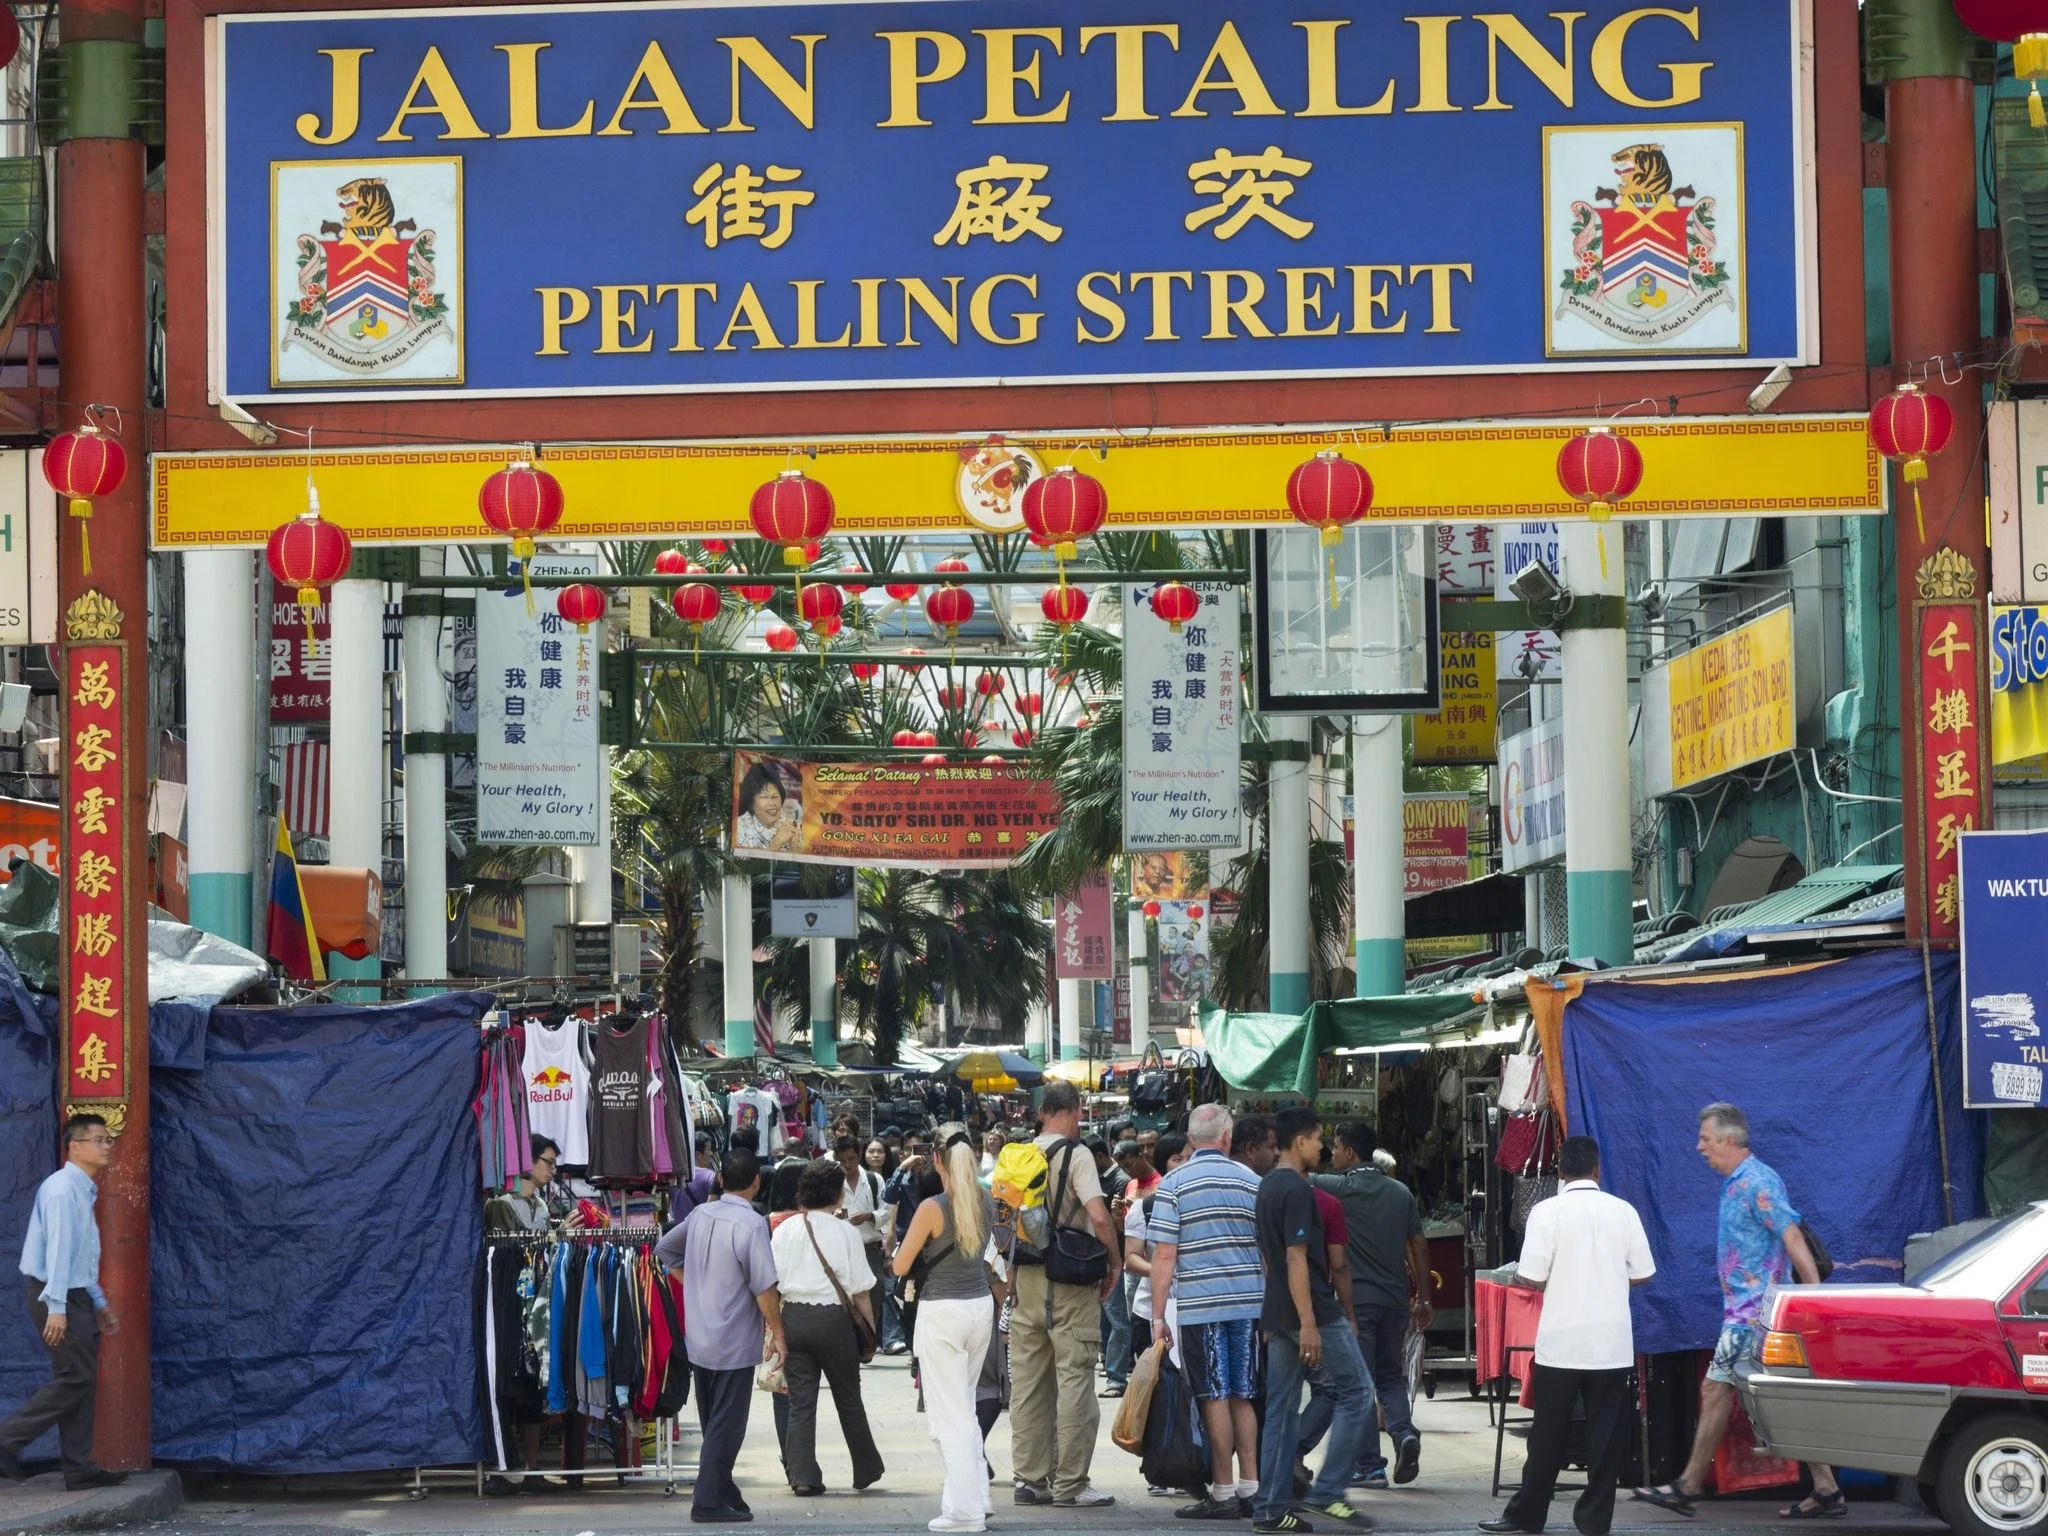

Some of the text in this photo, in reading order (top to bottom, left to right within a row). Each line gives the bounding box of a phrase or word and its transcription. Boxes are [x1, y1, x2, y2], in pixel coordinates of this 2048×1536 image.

[295, 6, 1714, 146] JALAN PETALING
[534, 262, 1473, 357] PETALING STREET
[1568, 288, 1725, 338] Dewan Bandaraya Kuala Lumpur
[294, 319, 443, 369] Dewan Bandaraya Kuala Lumpur
[539, 612, 562, 689] 你健康
[1702, 633, 1750, 686] KEDAI BEG
[1185, 626, 1206, 699] 你健康
[504, 668, 526, 744] 我自豪
[1672, 695, 1706, 742] CENTINEL
[1708, 675, 1749, 725] MARKETING
[1152, 679, 1172, 752] 我自豪
[815, 765, 922, 786] Selamat Datang
[934, 767, 993, 780] 热烈欢迎
[482, 784, 566, 798] Your Health,
[1131, 790, 1211, 803] Your Health,
[522, 802, 541, 816] My
[546, 802, 583, 816] Glory
[1169, 807, 1187, 820] My
[1192, 807, 1227, 820] Glory
[1404, 800, 1468, 829] OMOTION
[907, 814, 936, 828] SRI
[974, 813, 998, 827] NG
[1002, 813, 1034, 826] YEN
[481, 828, 595, 843] www.zhen-ao.com.my
[822, 831, 949, 843] GONG XI FA CAI
[1130, 832, 1240, 845] www.zhen-ao.com.my
[1404, 846, 1451, 857] hinatown
[1411, 857, 1435, 867] Room
[1437, 857, 1456, 867] Rate
[530, 1090, 553, 1103] Red
